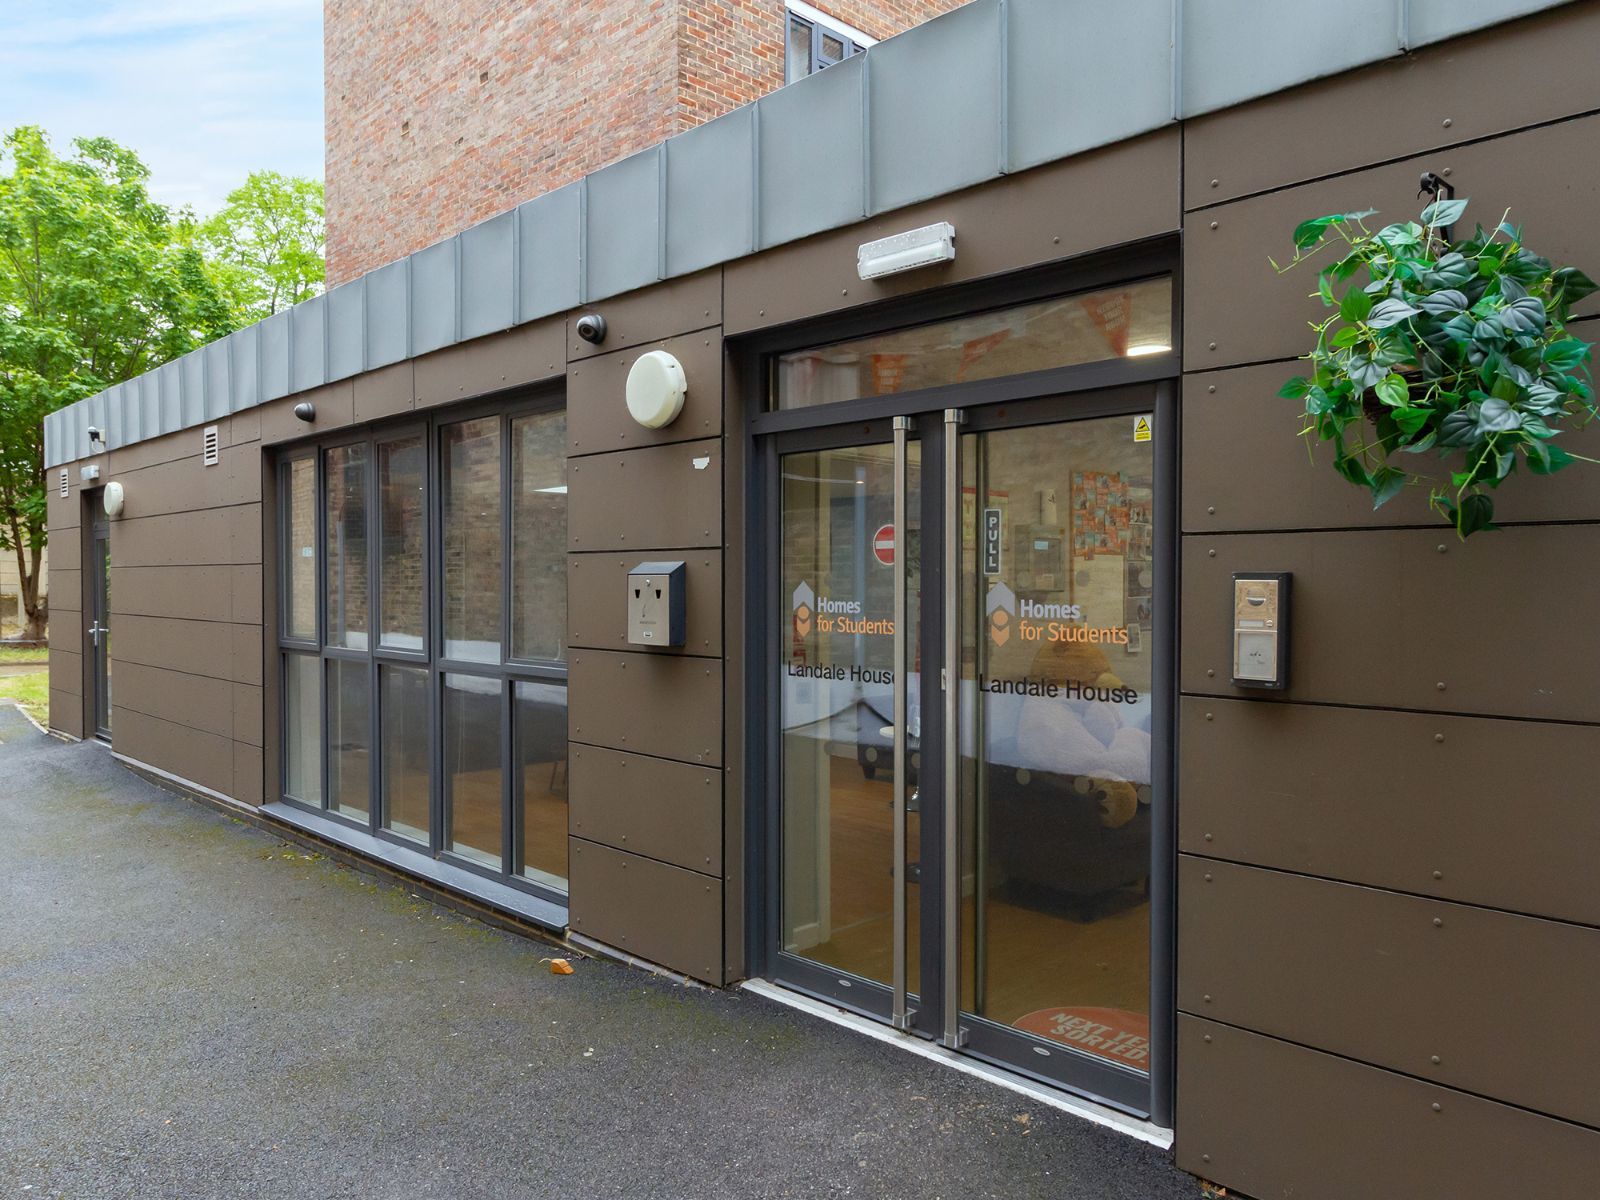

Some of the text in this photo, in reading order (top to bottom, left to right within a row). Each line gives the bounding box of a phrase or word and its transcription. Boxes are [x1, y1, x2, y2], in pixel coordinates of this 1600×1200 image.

[989, 516, 997, 567] PULL
[817, 597, 861, 613] Homes
[1020, 599, 1081, 619] Homes
[816, 615, 895, 634] for Students
[1019, 620, 1128, 644] for Students
[788, 660, 895, 684] Landale Hous
[979, 673, 1138, 704] Landale House
[1049, 1013, 1112, 1036] NEXT
